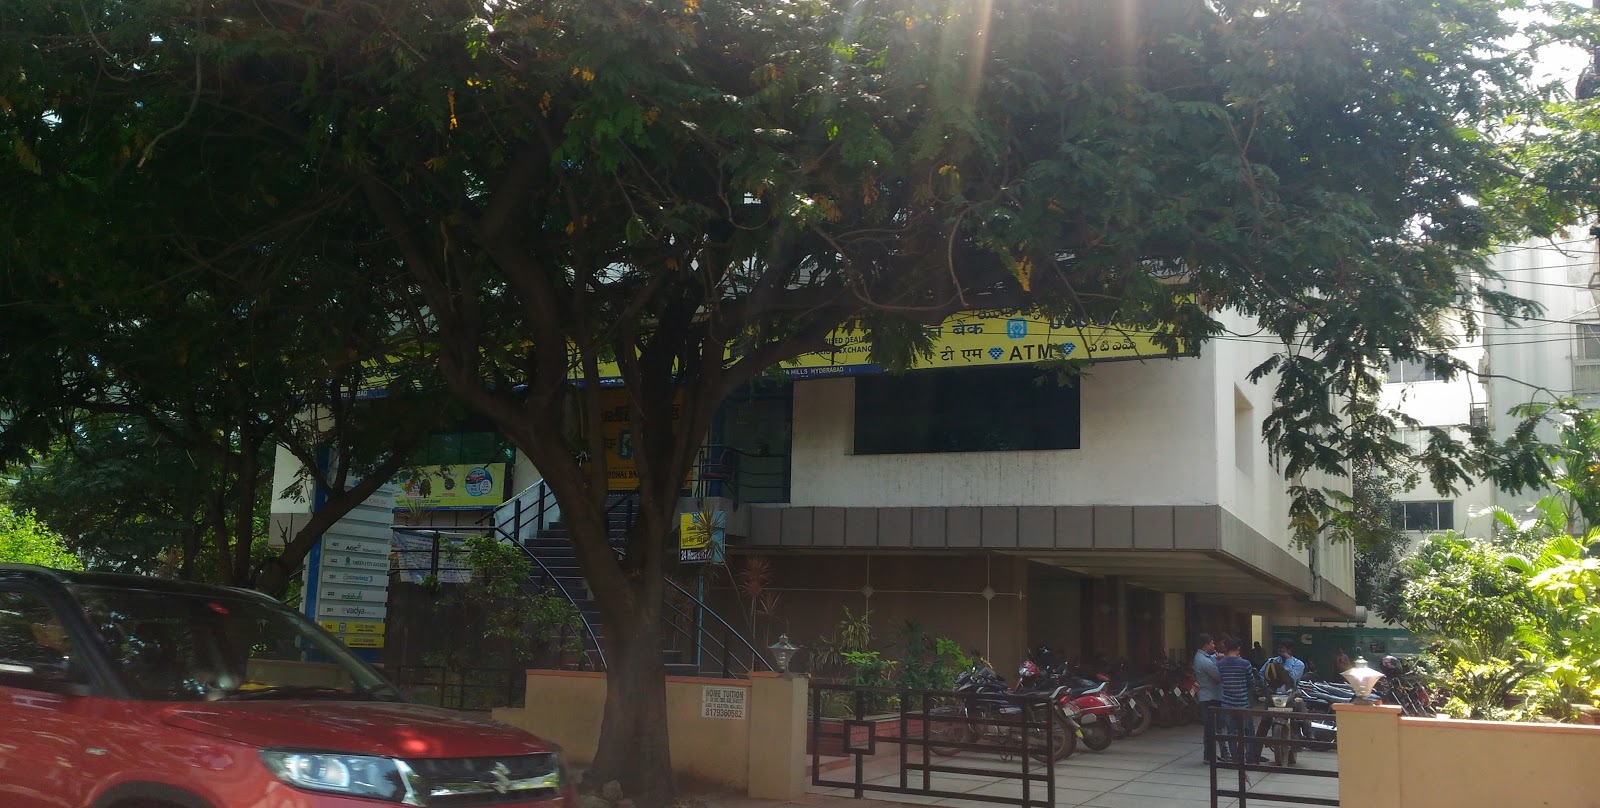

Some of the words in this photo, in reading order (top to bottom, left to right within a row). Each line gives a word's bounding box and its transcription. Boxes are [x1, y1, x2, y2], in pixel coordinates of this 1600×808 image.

[1009, 344, 1054, 361] ATM
[811, 366, 844, 375] HYDERABAD
[705, 689, 721, 698] HOME
[723, 690, 744, 699] TUITION
